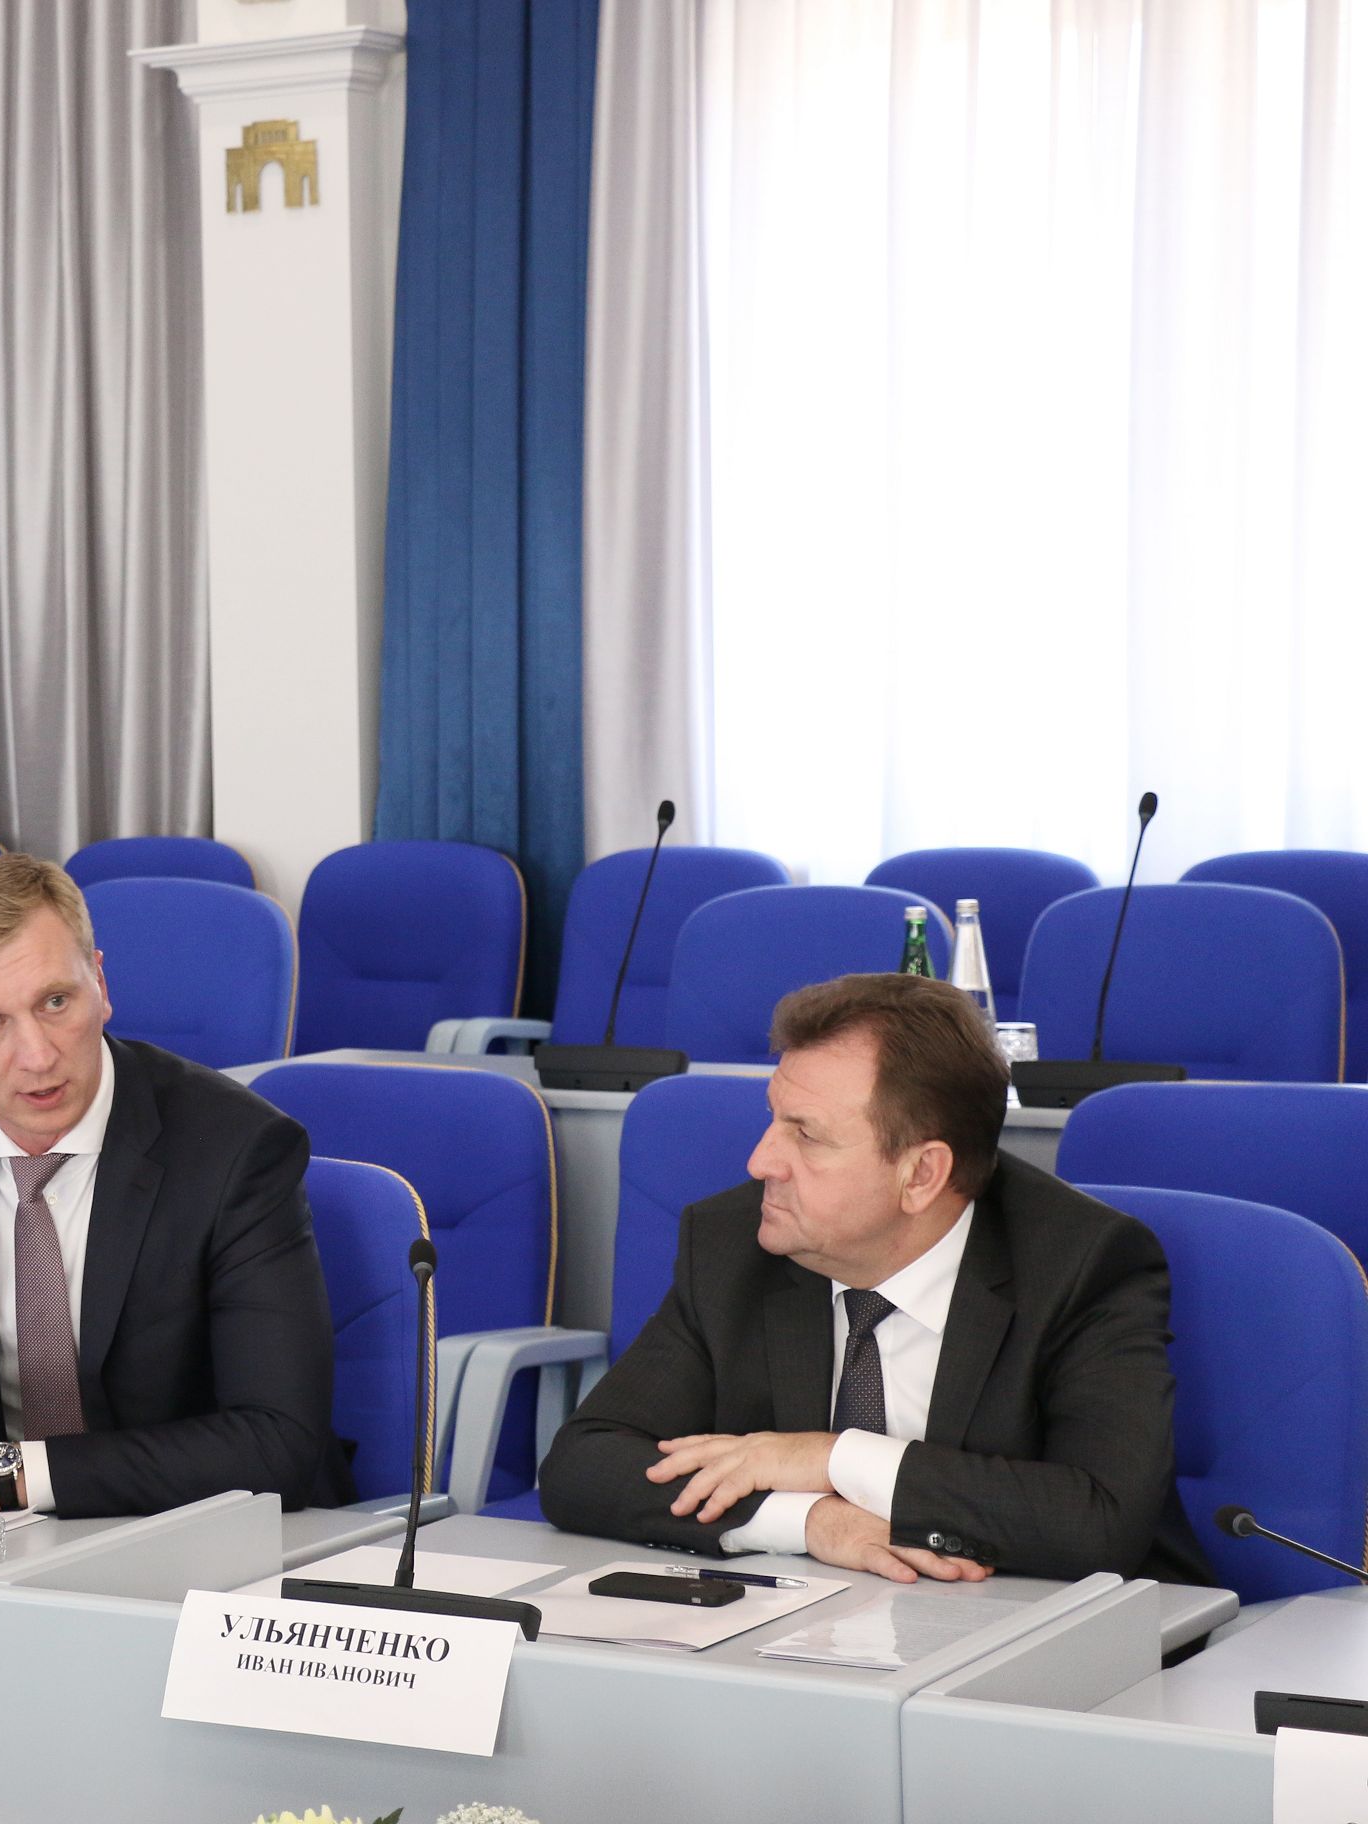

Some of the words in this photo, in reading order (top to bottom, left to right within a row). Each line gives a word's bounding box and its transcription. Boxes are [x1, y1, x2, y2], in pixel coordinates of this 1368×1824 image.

[220, 1614, 450, 1663] УЛЬЯНЧЕНКО
[237, 1653, 294, 1675] ИВАН
[298, 1662, 417, 1689] ИВАНОВИЧ
